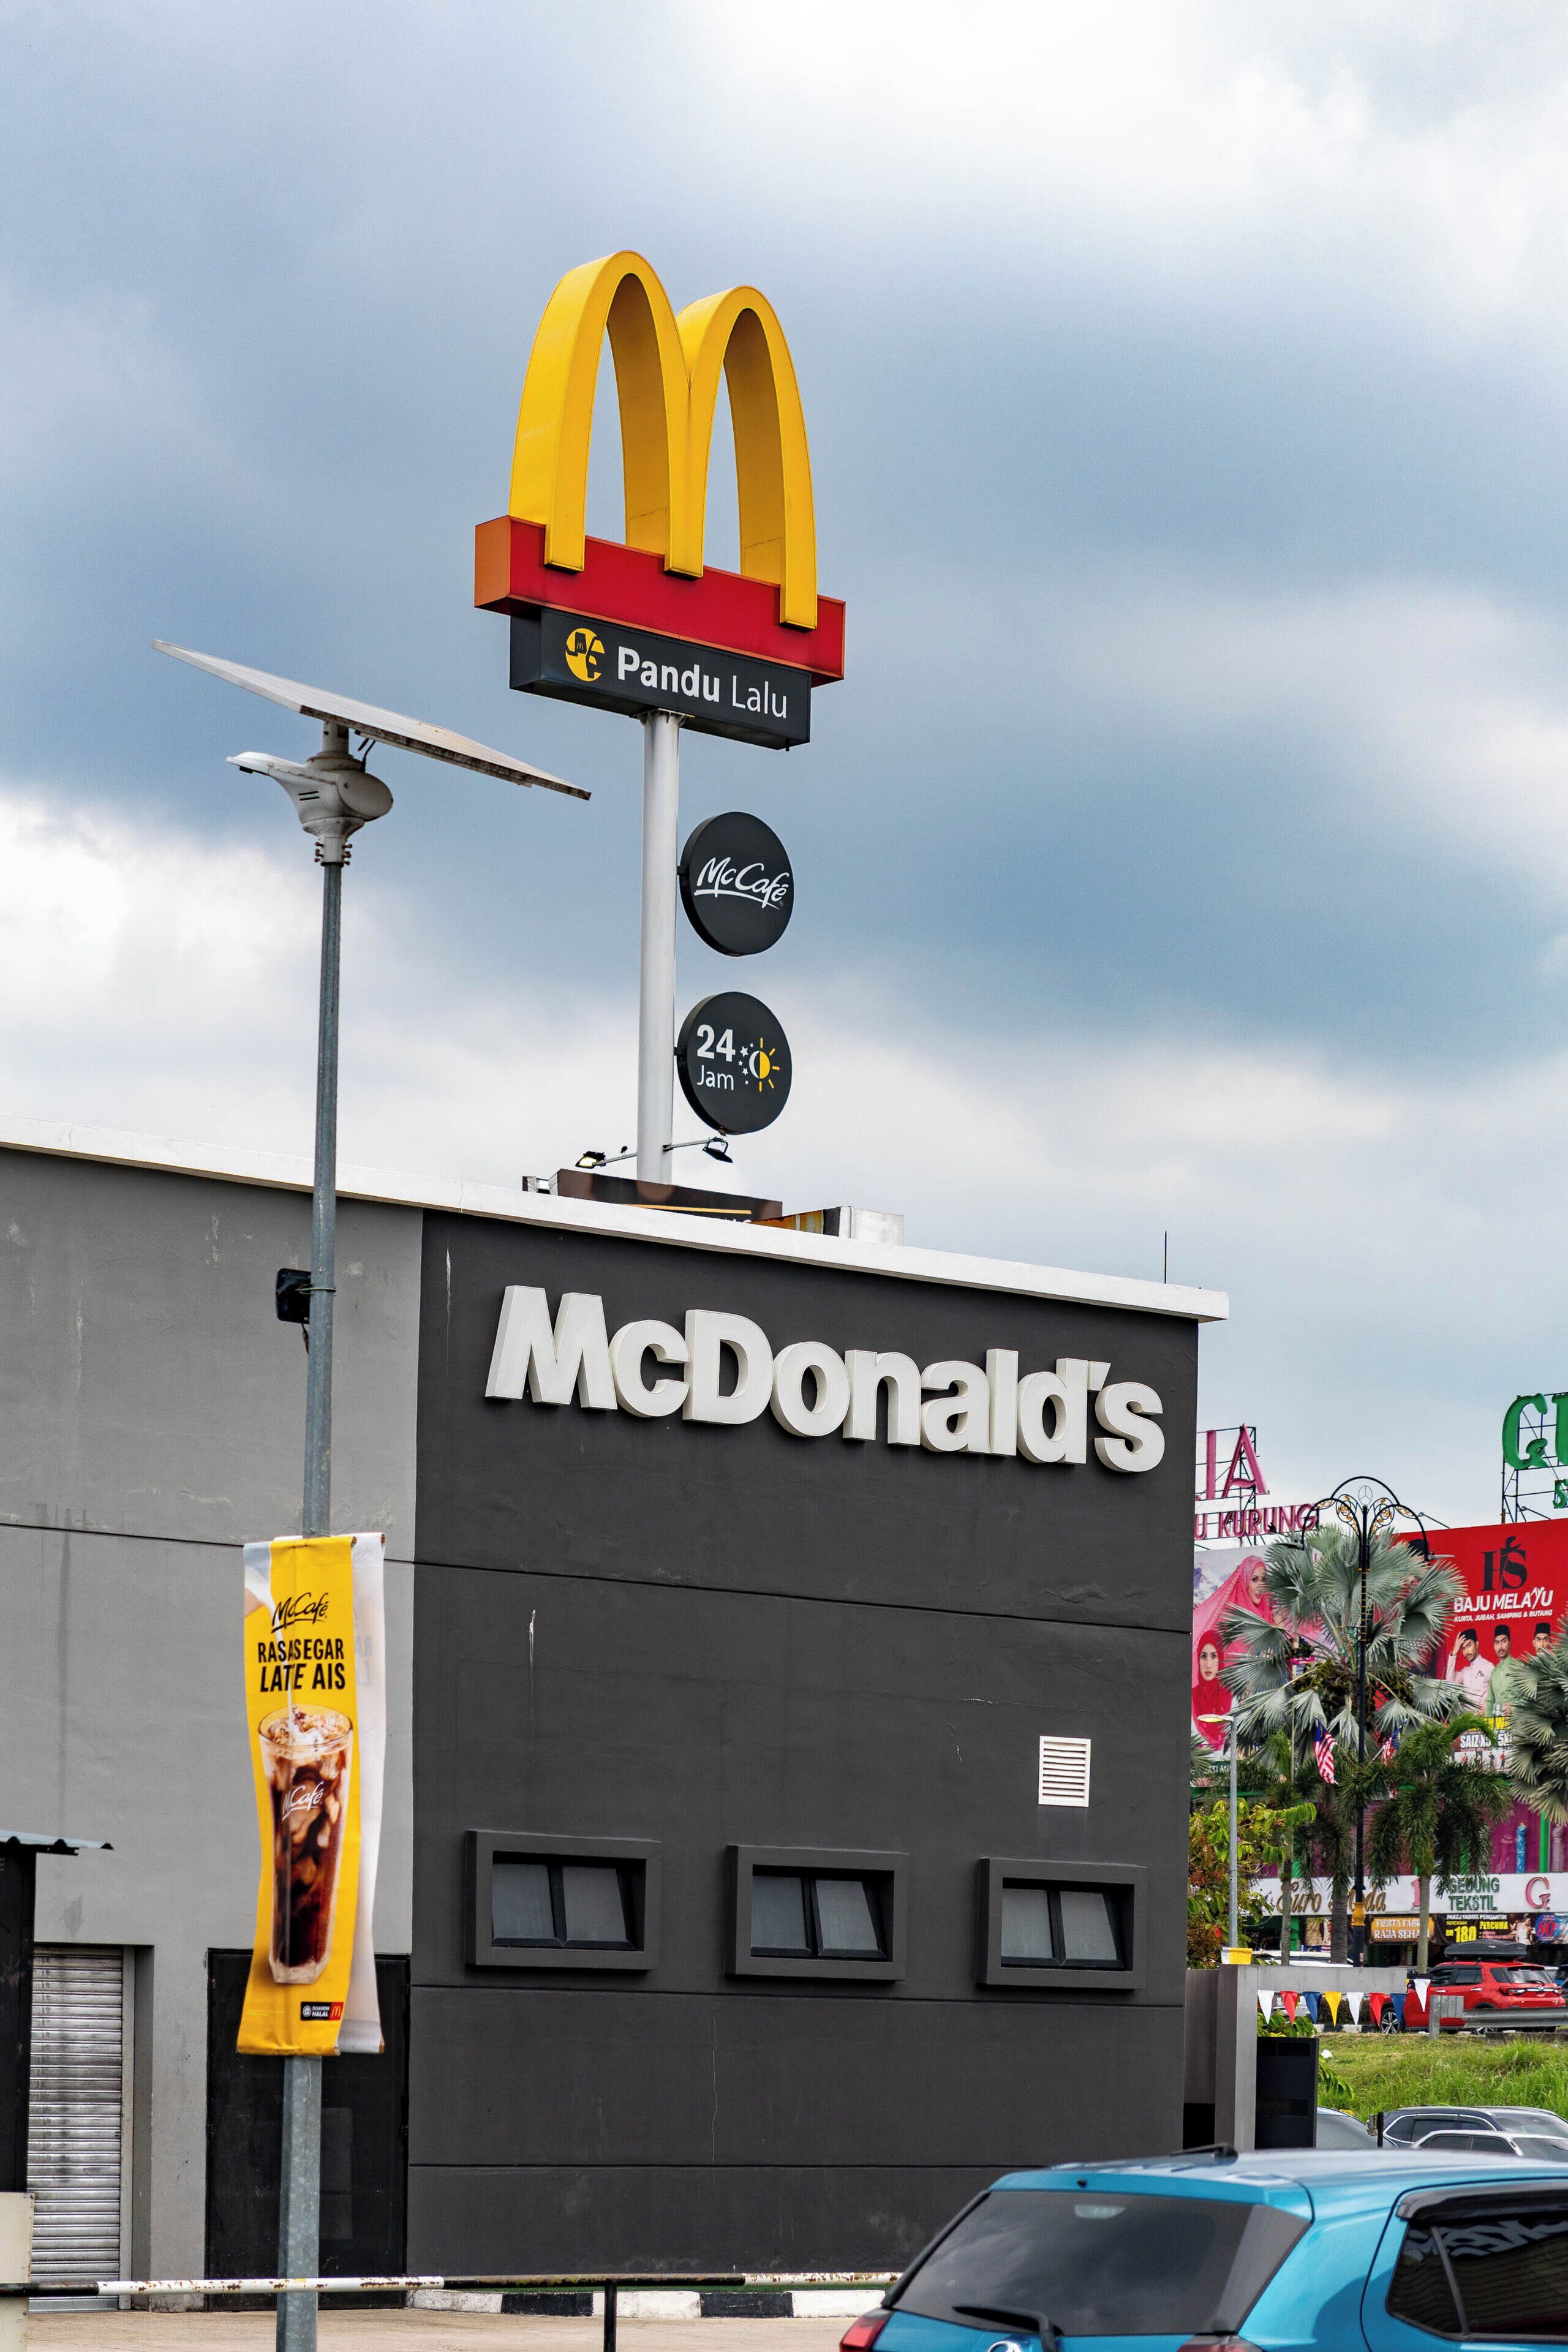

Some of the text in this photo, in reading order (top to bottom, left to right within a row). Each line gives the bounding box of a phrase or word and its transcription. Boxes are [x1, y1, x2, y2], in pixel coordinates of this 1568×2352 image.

[617, 646, 788, 719] Pandu Lalu
[694, 857, 790, 910] McCafé
[696, 1023, 736, 1063] 24
[697, 1065, 734, 1091] Jam
[484, 1284, 1166, 1473] McDonald's
[1218, 1503, 1317, 1538] KURUNG
[271, 1593, 329, 1634] McCafé
[1453, 1586, 1554, 1613] BAJU MELAYU
[1475, 1613, 1494, 1622] JUBAH,
[1496, 1611, 1522, 1620] SAMPING
[1529, 1609, 1553, 1618] BUTANG
[260, 1662, 345, 1692] LATE AIS
[1460, 1734, 1479, 1748] SAIZ
[1449, 1895, 1498, 1910] TEKSTIL
[1455, 1926, 1477, 1943] 180
